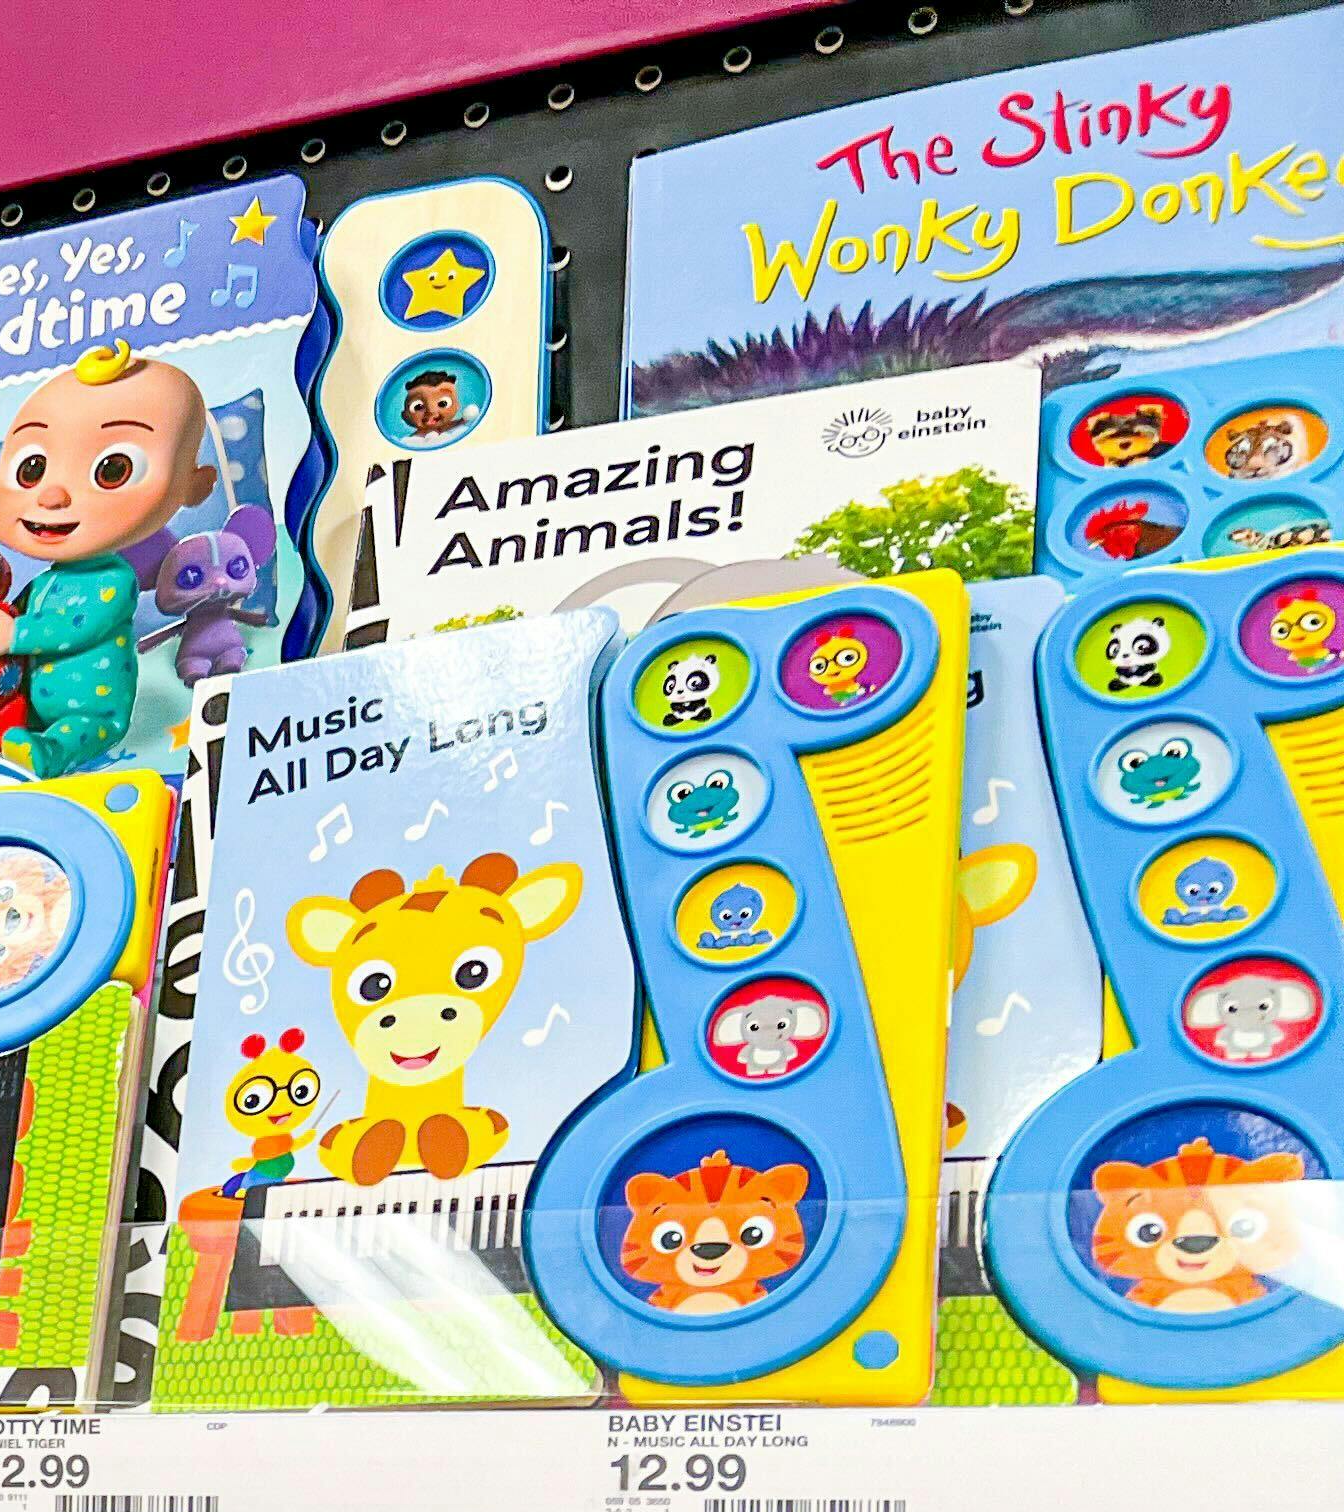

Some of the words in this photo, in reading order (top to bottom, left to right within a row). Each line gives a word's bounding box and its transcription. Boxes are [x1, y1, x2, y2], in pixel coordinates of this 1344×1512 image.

[818, 127, 958, 194] The
[983, 80, 1233, 168] Stinky
[58, 234, 148, 287] Yes,
[743, 200, 1022, 305] Wonky
[434, 437, 757, 521] Amazing
[426, 492, 746, 577] Animals!
[246, 694, 385, 757] Music
[247, 752, 312, 805] All
[324, 736, 410, 790] Day
[427, 697, 549, 753] Long
[27, 1438, 65, 1449] TIGER
[50, 1419, 101, 1435] TIME
[608, 1415, 675, 1432] BABY
[683, 1414, 782, 1432] EINSTEI
[633, 1436, 685, 1448] MUSIC
[689, 1436, 719, 1448] ALL
[723, 1436, 757, 1448] DAY
[762, 1436, 809, 1448] LONG
[611, 1453, 747, 1492] 12.99
